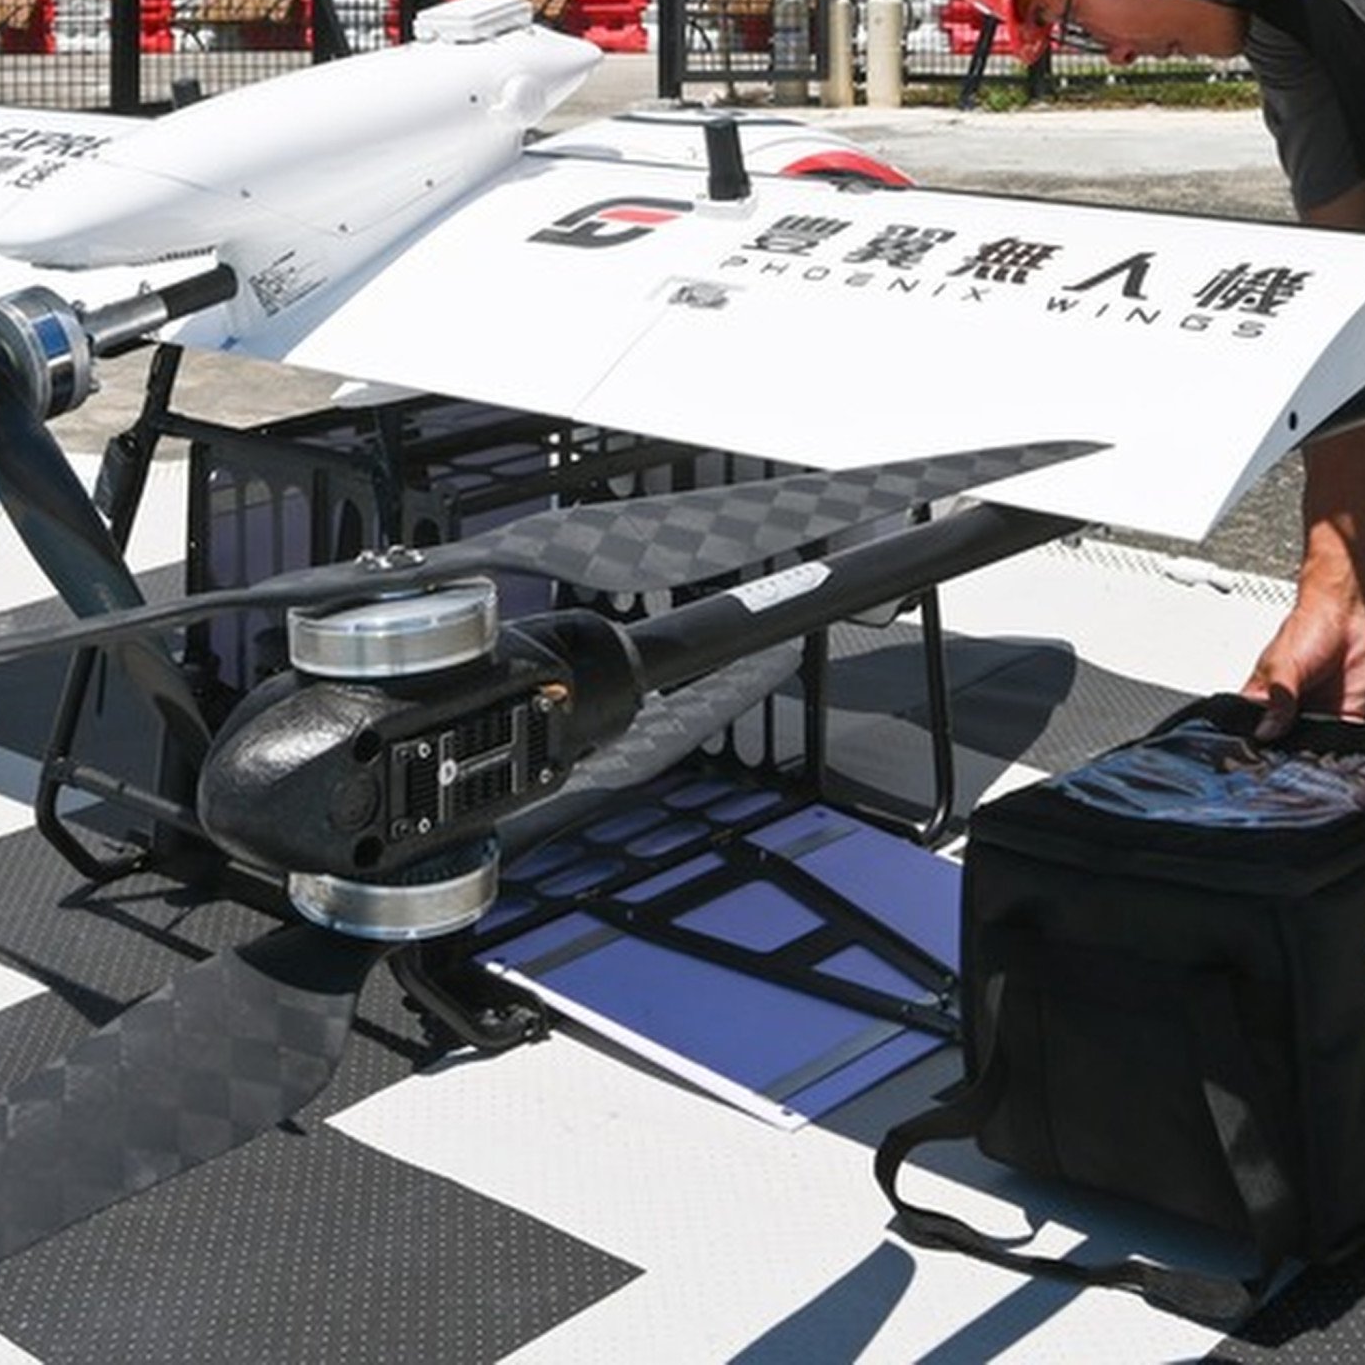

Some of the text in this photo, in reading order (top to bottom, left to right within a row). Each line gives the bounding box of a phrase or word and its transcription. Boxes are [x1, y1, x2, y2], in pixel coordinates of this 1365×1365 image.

[719, 255, 992, 302] PHOENIX
[1046, 296, 1266, 338] WINGS
[741, 214, 1315, 318] 豐翼無人機
